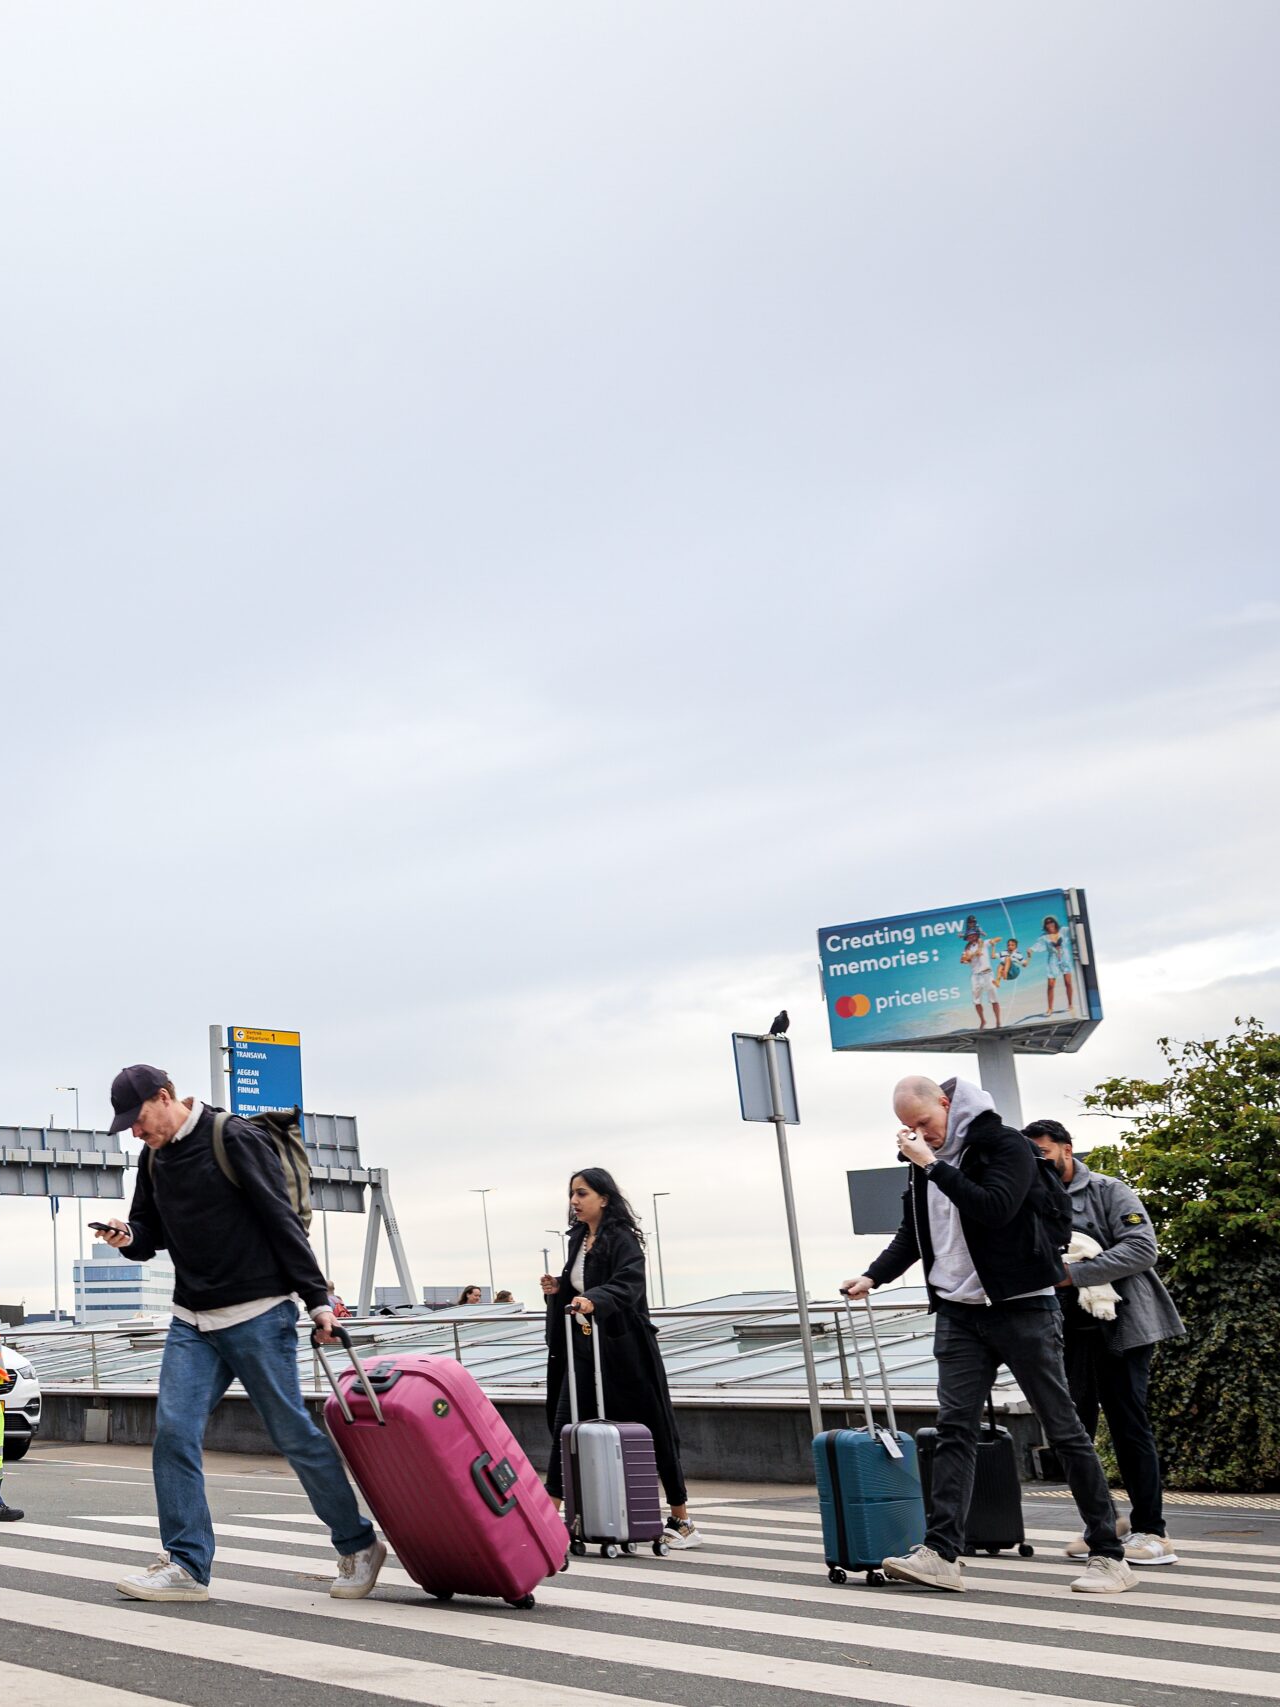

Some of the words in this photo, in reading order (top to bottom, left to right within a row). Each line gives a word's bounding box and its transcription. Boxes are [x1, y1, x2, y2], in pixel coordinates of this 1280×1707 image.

[826, 927, 915, 952] Creating
[921, 919, 964, 938] new
[829, 948, 939, 977] memories:
[876, 987, 960, 1013] priceless
[271, 1033, 276, 1042] 1
[236, 1051, 267, 1060] TRANSAVIA
[237, 1077, 258, 1085] AMELIA
[237, 1086, 260, 1094] FINNAIR
[238, 1104, 257, 1112] IBERIA
